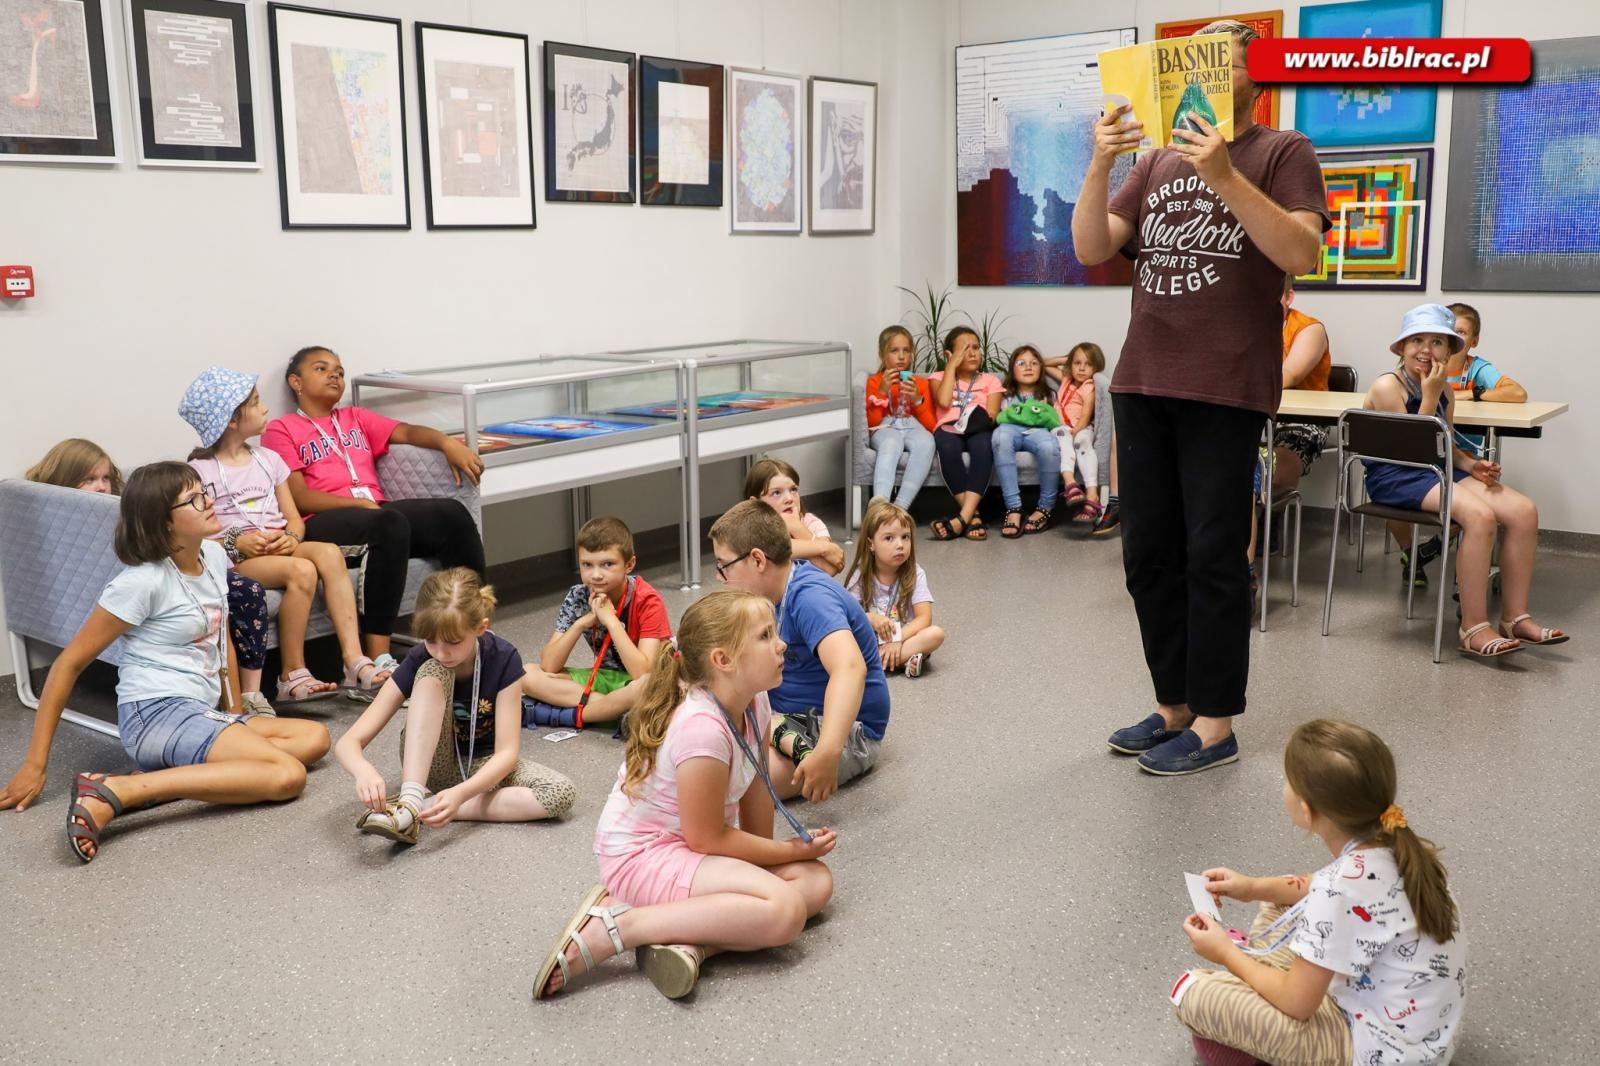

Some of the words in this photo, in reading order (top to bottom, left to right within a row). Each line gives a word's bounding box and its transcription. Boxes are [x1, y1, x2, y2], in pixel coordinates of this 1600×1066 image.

[1158, 40, 1229, 73] BAŚNIE
[1207, 83, 1229, 94] DZIECI
[1166, 200, 1190, 213] EST.
[1142, 213, 1180, 247] New
[1177, 213, 1244, 252] York
[1151, 253, 1197, 268] SPORTS
[1140, 260, 1221, 295] COLLEGE
[1384, 1005, 1418, 1021] Love
